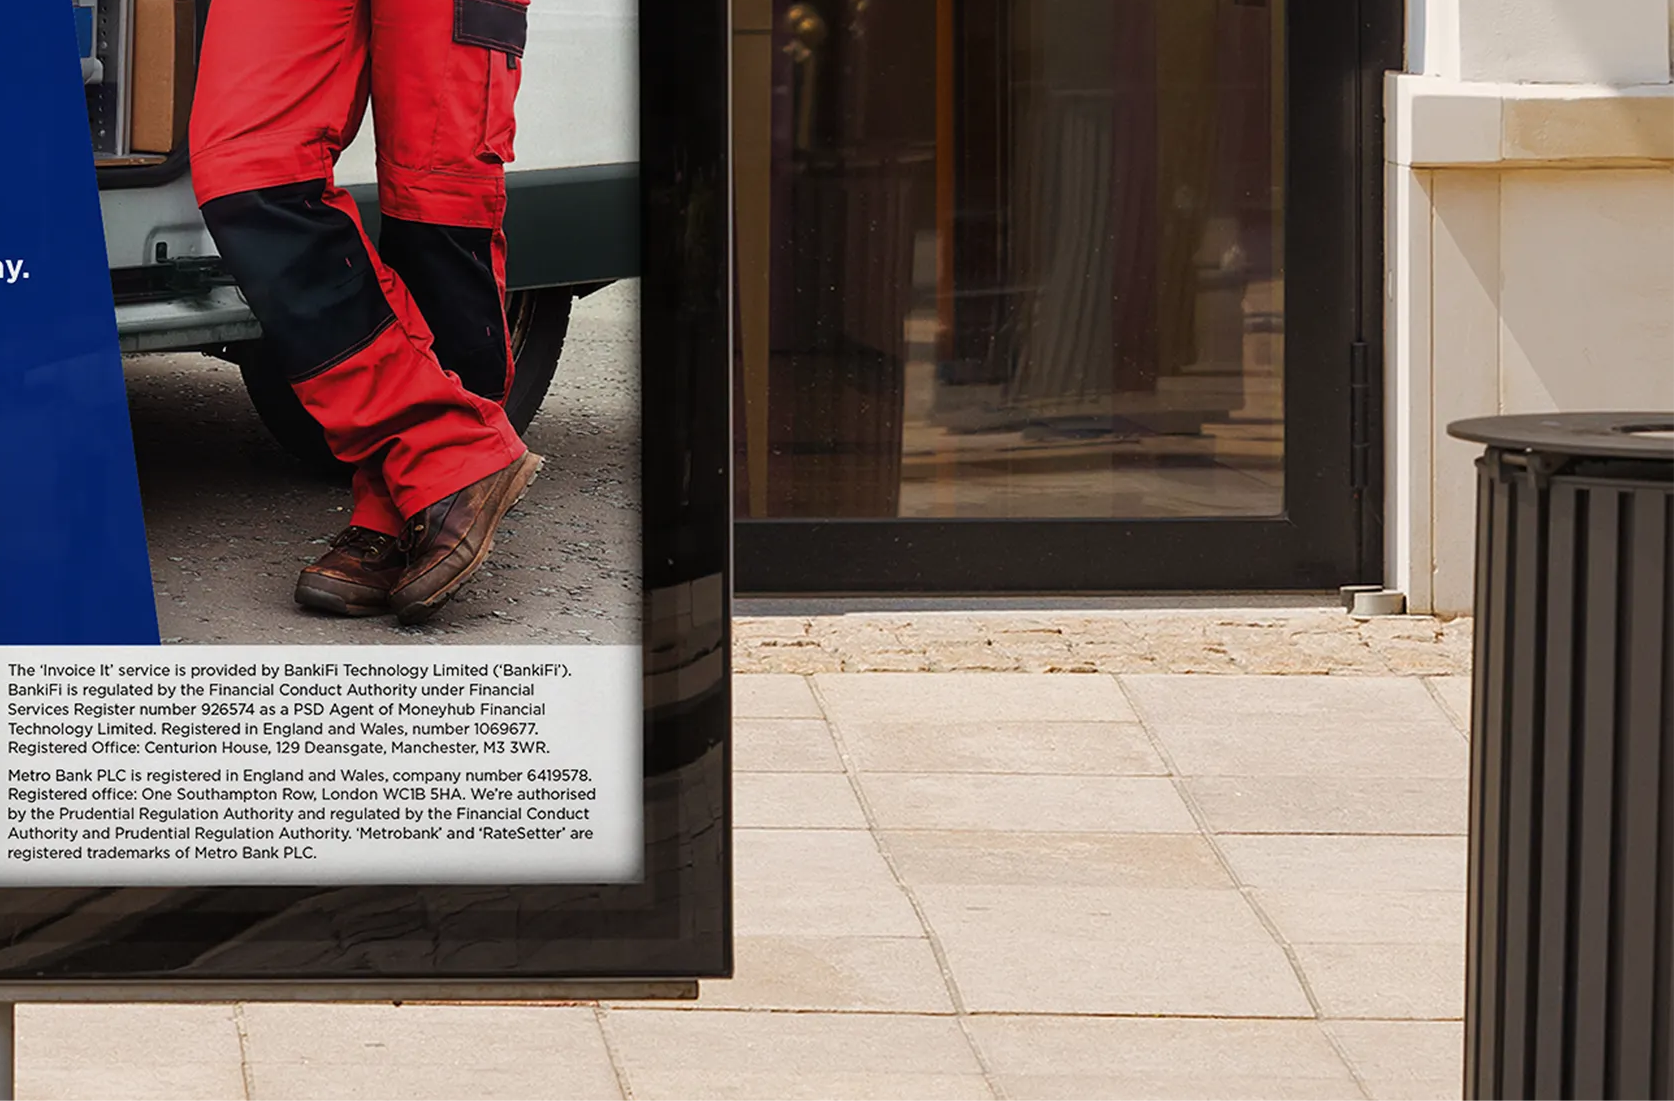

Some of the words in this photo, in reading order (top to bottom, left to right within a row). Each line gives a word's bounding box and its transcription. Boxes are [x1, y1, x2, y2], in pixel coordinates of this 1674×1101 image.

[8, 664, 35, 676] The
[119, 664, 170, 676] service
[176, 664, 186, 676] is
[191, 664, 256, 679] provided
[262, 664, 279, 679] by
[285, 664, 338, 676] BankiFi
[343, 664, 428, 679] Technology
[434, 664, 488, 676] Limited
[9, 684, 61, 696] BankiFi
[68, 684, 78, 696] is
[83, 684, 153, 698] regulated
[158, 684, 176, 698] by
[181, 684, 204, 696] the
[210, 684, 273, 696] Financial
[280, 684, 342, 696] Conduct
[347, 684, 417, 698] Authority
[422, 684, 464, 696] under
[470, 684, 534, 696] Financial
[8, 703, 69, 715] Services
[75, 703, 135, 718] Register
[140, 703, 196, 715] number
[202, 703, 255, 715] 926574
[260, 706, 275, 715] as
[280, 706, 288, 715] a
[294, 703, 324, 715] PSD
[329, 703, 374, 718] Agent
[379, 703, 394, 715] of
[399, 703, 475, 718] Moneyhub
[481, 703, 545, 715] Financial
[8, 723, 93, 737] Technology
[98, 723, 156, 735] Limited.
[162, 723, 240, 737] Registered
[245, 723, 258, 734] in
[264, 723, 322, 737] England
[328, 723, 355, 735] and
[360, 723, 407, 736] Wales,
[413, 723, 470, 735] number
[474, 723, 538, 735] 1069677.
[9, 741, 87, 756] Registered
[92, 741, 139, 753] Office:
[145, 741, 217, 753] Centurion
[223, 742, 271, 754] House,
[277, 741, 300, 753] 129
[305, 741, 386, 756] Deansgate,
[392, 742, 478, 754] Manchester,
[484, 741, 505, 753] M3
[510, 741, 549, 753] 3WR.
[9, 769, 50, 781] Metro
[56, 769, 92, 781] Bank
[98, 769, 126, 781] PLC
[131, 769, 141, 781] is
[147, 769, 221, 784] registered
[226, 770, 238, 781] in
[244, 769, 303, 784] England
[309, 769, 335, 781] and
[341, 769, 388, 782] Wales,
[393, 772, 461, 784] company
[466, 770, 522, 781] number
[527, 769, 591, 781] 6419578.
[9, 788, 87, 803] Registered
[92, 788, 137, 800] office:
[142, 788, 172, 800] One
[177, 788, 277, 802] Southampton
[283, 788, 316, 801] Row,
[322, 788, 377, 800] London
[383, 788, 426, 800] WC1B
[431, 788, 465, 800] 5HA.
[517, 788, 595, 800] authorised
[8, 807, 26, 822] by
[31, 807, 54, 819] the
[60, 807, 134, 819] Prudential
[140, 807, 218, 822] Regulation
[223, 808, 293, 822] Authority
[298, 807, 325, 819] and
[331, 807, 400, 822] regulated
[406, 808, 423, 822] by
[428, 807, 452, 819] the
[457, 807, 521, 819] Financial
[527, 807, 589, 820] Conduct
[8, 827, 78, 842] Authority
[82, 827, 110, 839] and
[116, 827, 189, 839] Prudential
[195, 827, 274, 842] Regulation
[279, 827, 351, 842] Authority.
[447, 827, 474, 839] and
[570, 829, 593, 839] are
[8, 847, 82, 862] registered
[87, 846, 170, 859] trademarks
[175, 846, 190, 859] of
[195, 847, 237, 859] Metro
[243, 846, 279, 859] Bank
[284, 846, 316, 859] PLC.
